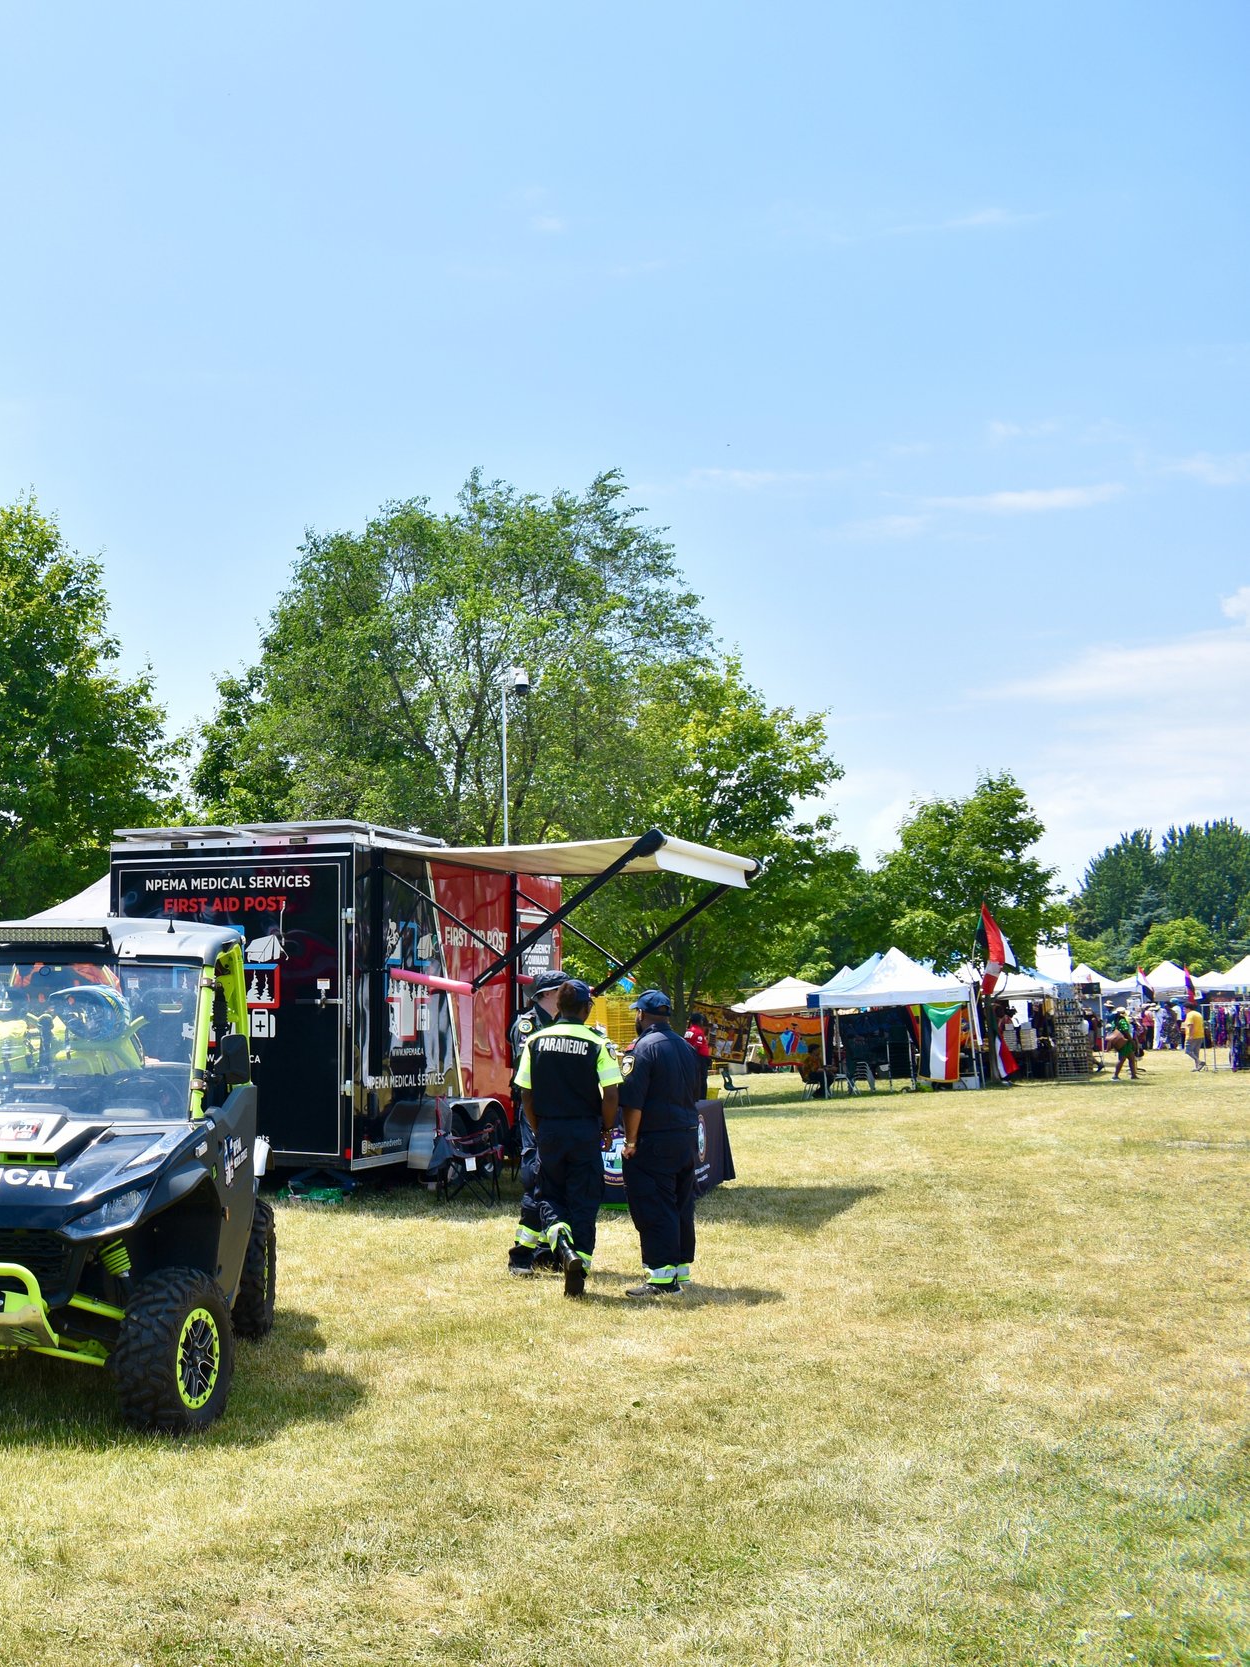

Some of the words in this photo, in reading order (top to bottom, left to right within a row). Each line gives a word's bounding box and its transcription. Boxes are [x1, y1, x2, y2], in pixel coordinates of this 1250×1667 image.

[145, 879, 188, 891] NPEMA
[191, 877, 246, 890] MEDICAL
[249, 875, 311, 888] SERVICES
[164, 898, 207, 913] FIRST
[211, 896, 240, 912] AID
[244, 895, 287, 912] POST
[444, 926, 468, 947] FIRST
[487, 930, 508, 950] POST
[538, 1037, 589, 1056] PARAMEDIC
[366, 1075, 389, 1090] NPEMA
[390, 1073, 417, 1088] MEDICAL
[417, 1072, 445, 1087] SERVICES
